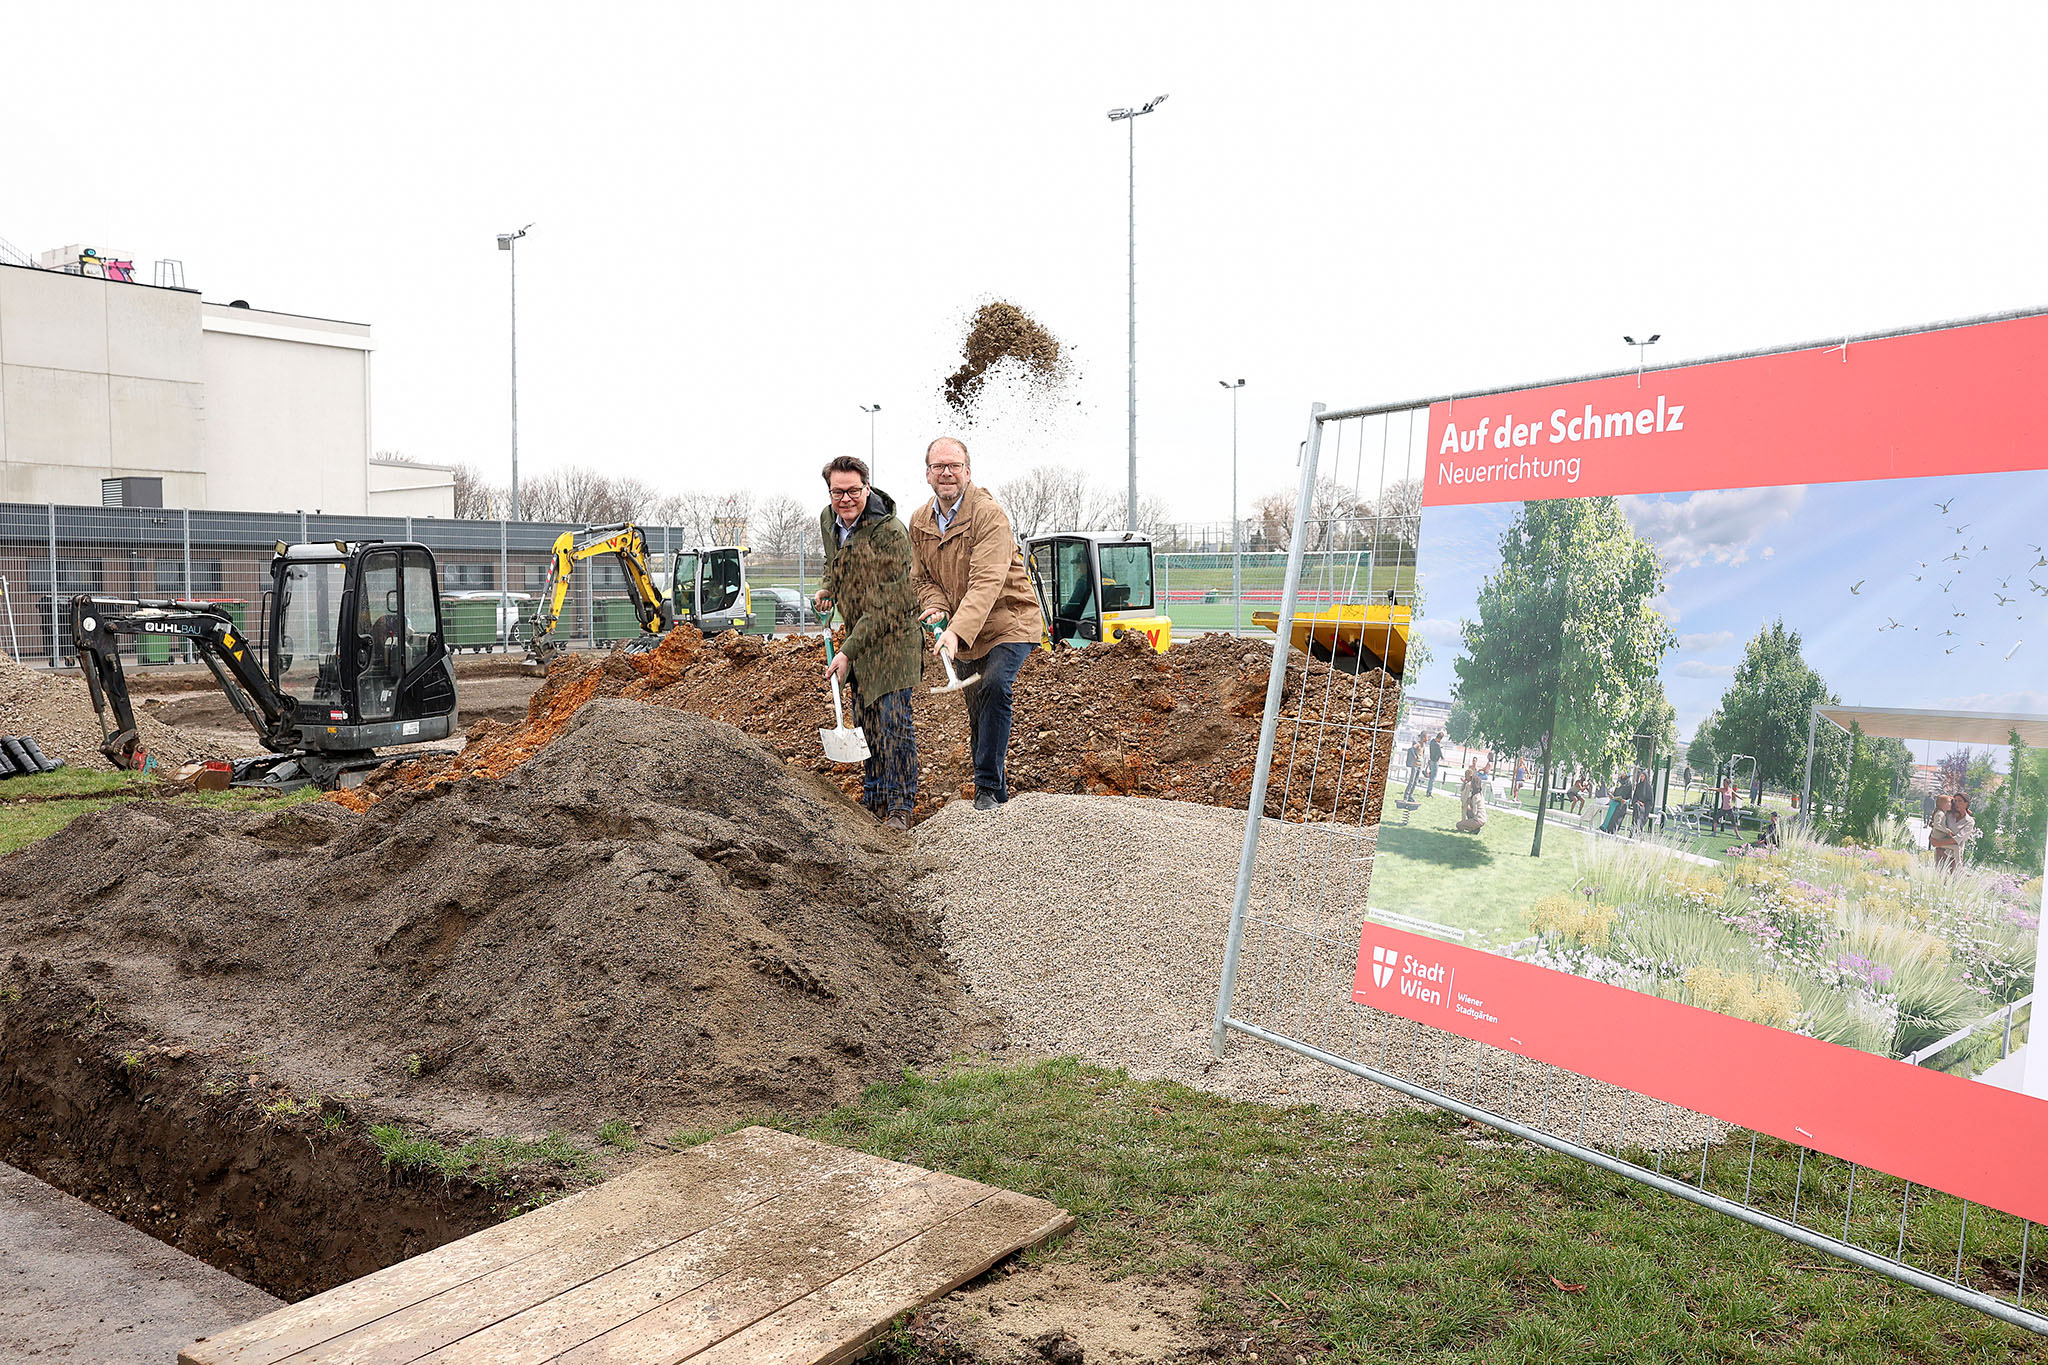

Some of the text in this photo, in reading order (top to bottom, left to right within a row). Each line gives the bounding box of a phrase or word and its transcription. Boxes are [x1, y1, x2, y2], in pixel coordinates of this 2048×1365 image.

[1439, 395, 1685, 454] Auf der Schmelz
[1438, 455, 1581, 485] Neuerrichtung
[1402, 954, 1446, 984] Stadt
[1400, 975, 1441, 1006] Wien
[1457, 992, 1484, 1008] Wiener
[1455, 1003, 1499, 1024] Stadtgärten
